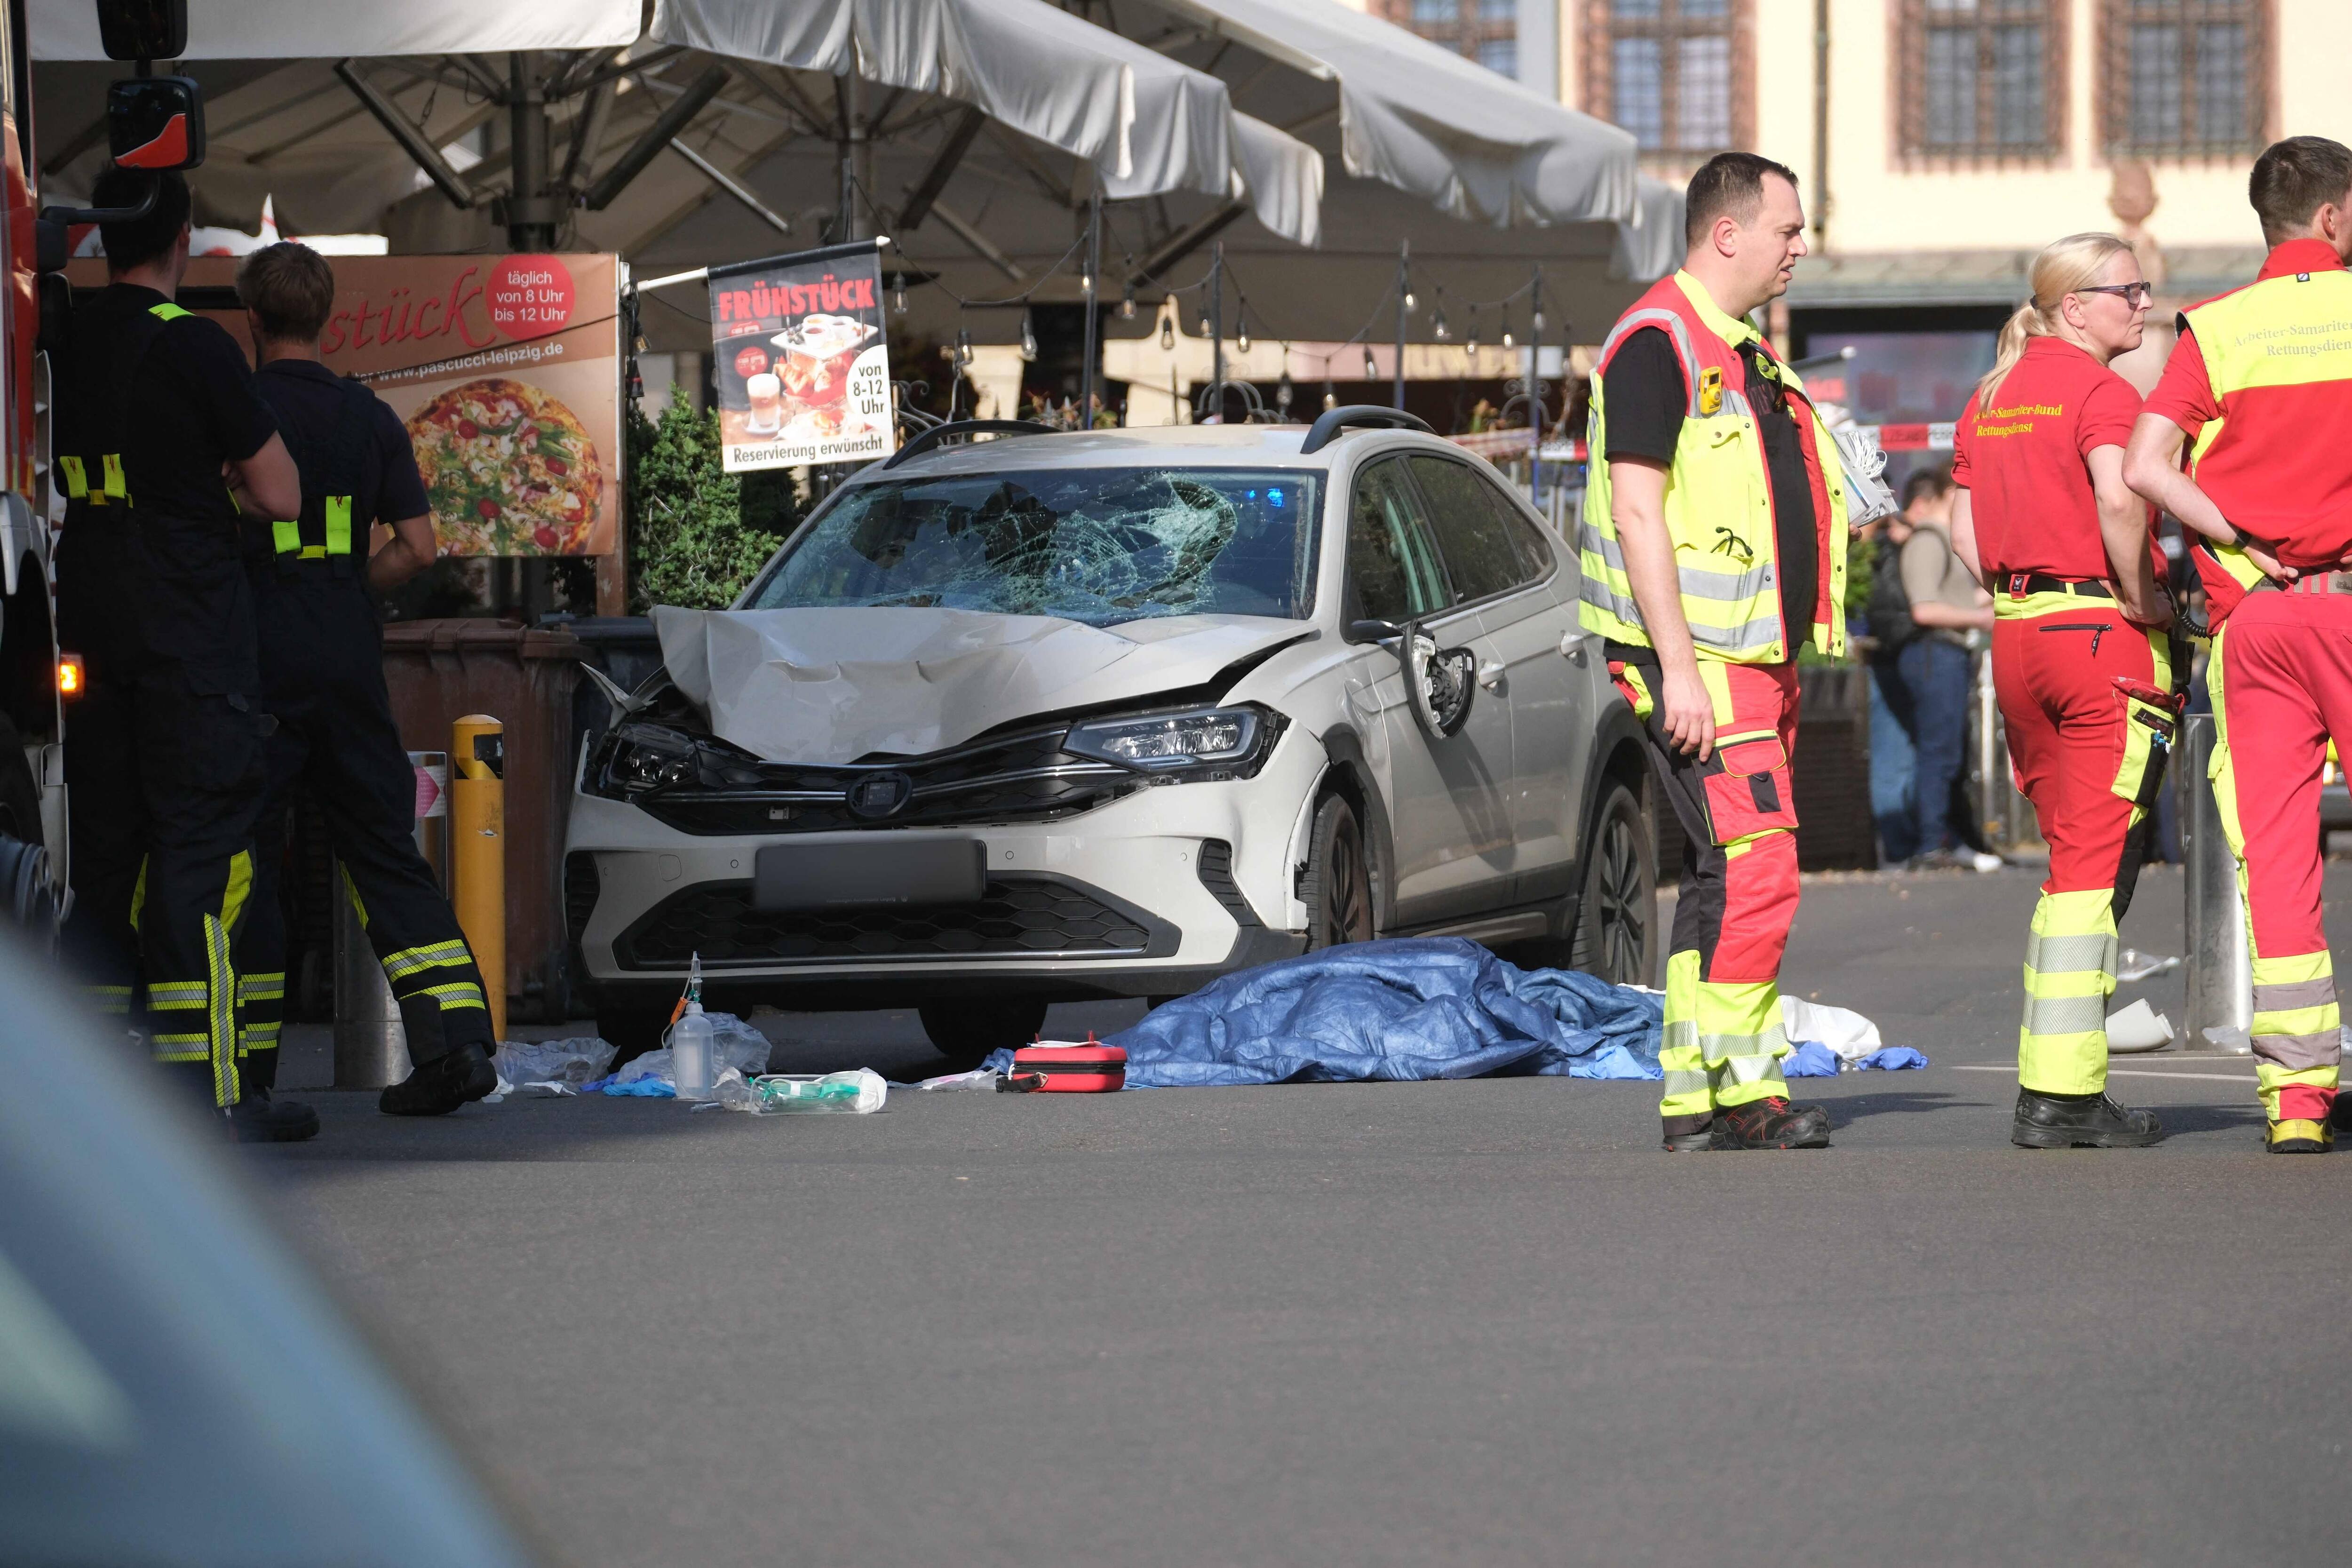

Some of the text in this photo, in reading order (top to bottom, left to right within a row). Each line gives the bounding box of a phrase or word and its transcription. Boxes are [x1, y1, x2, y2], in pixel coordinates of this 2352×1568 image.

[508, 271, 552, 287] täglich
[497, 289, 564, 302] von 8 Uhr
[719, 274, 875, 321] FRÜHSTÜCK
[495, 307, 566, 321] bis 12 Uhr
[377, 342, 564, 382] www.pascucci-leipzig.de
[858, 366, 882, 377] von
[853, 380, 883, 396] 8-12
[861, 398, 884, 414] Uhr
[1976, 422, 2033, 438] Rettungsdienst
[734, 436, 882, 463] Reservierung erwünscht
